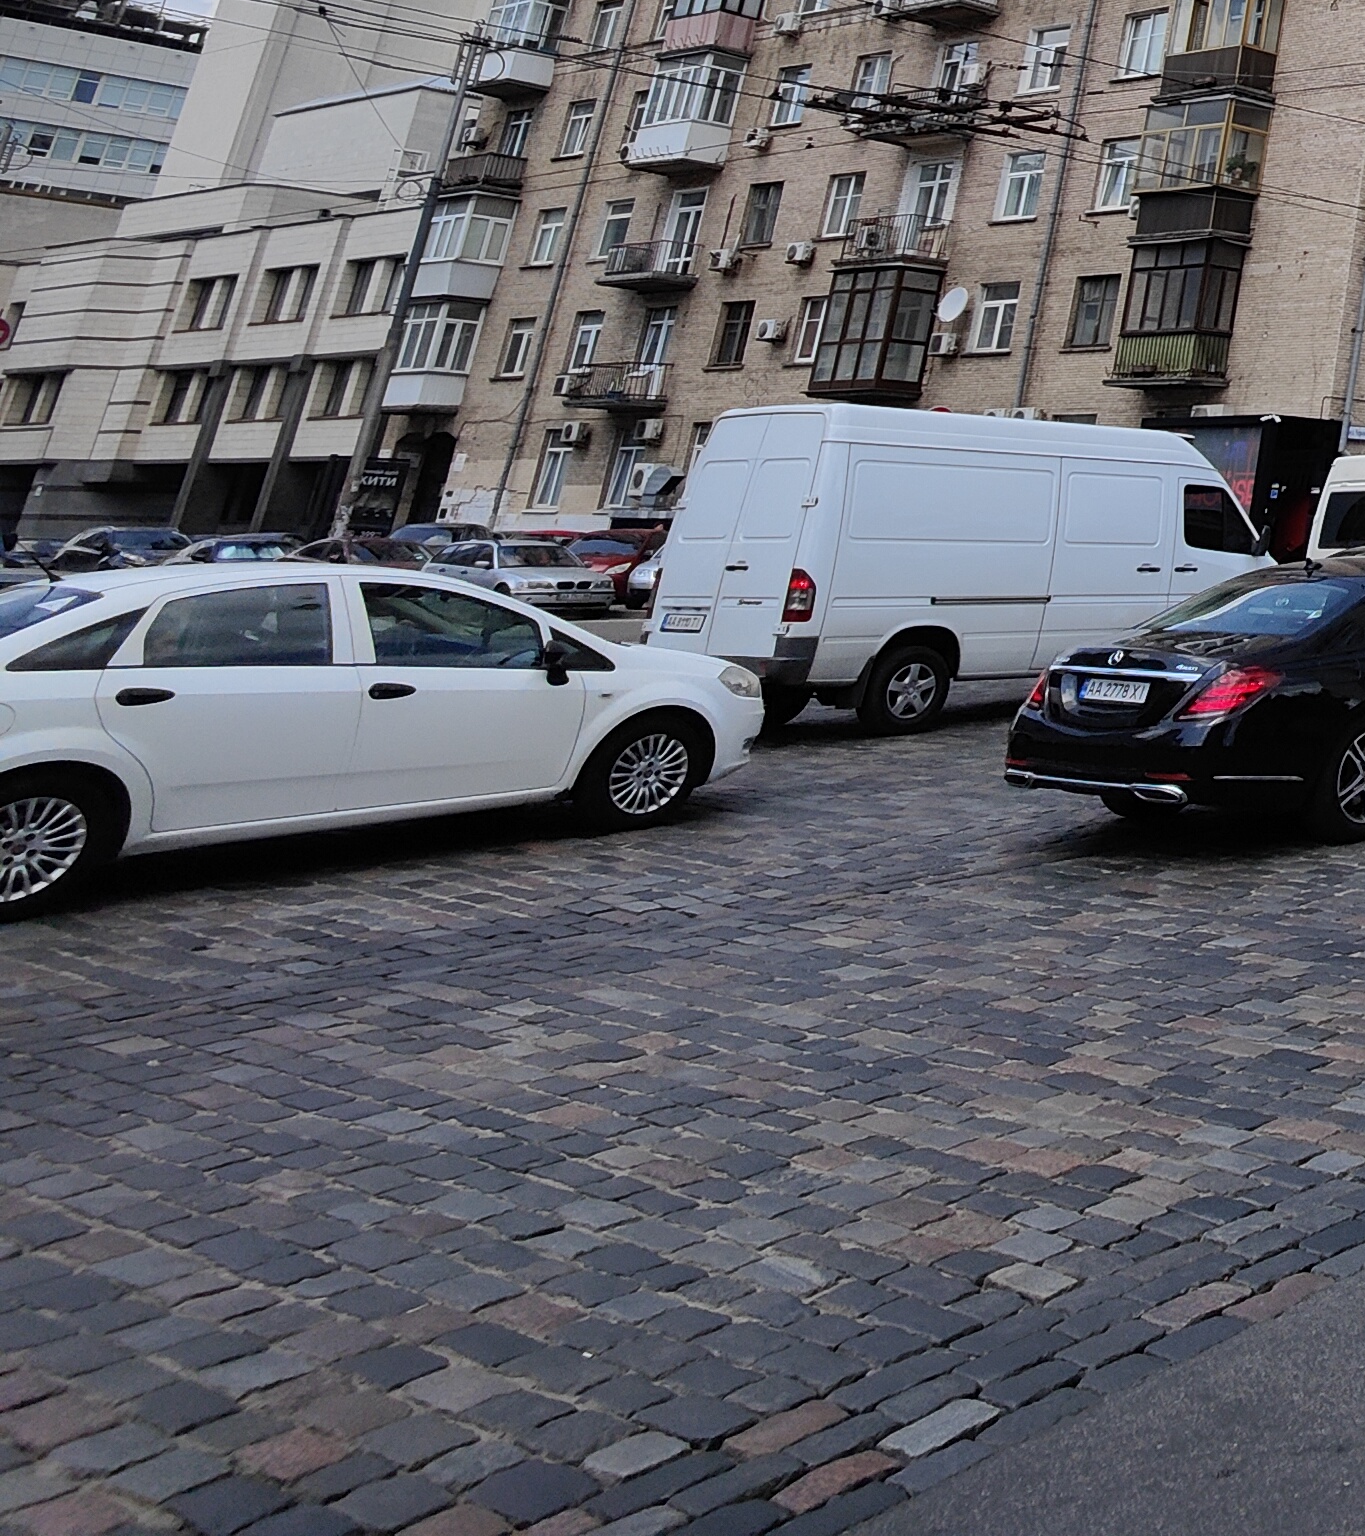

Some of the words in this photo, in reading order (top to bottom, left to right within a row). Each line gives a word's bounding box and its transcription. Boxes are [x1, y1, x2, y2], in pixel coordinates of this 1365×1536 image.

[1087, 681, 1101, 695] AA
[1103, 682, 1129, 698] 2778
[1130, 684, 1145, 700] XI
